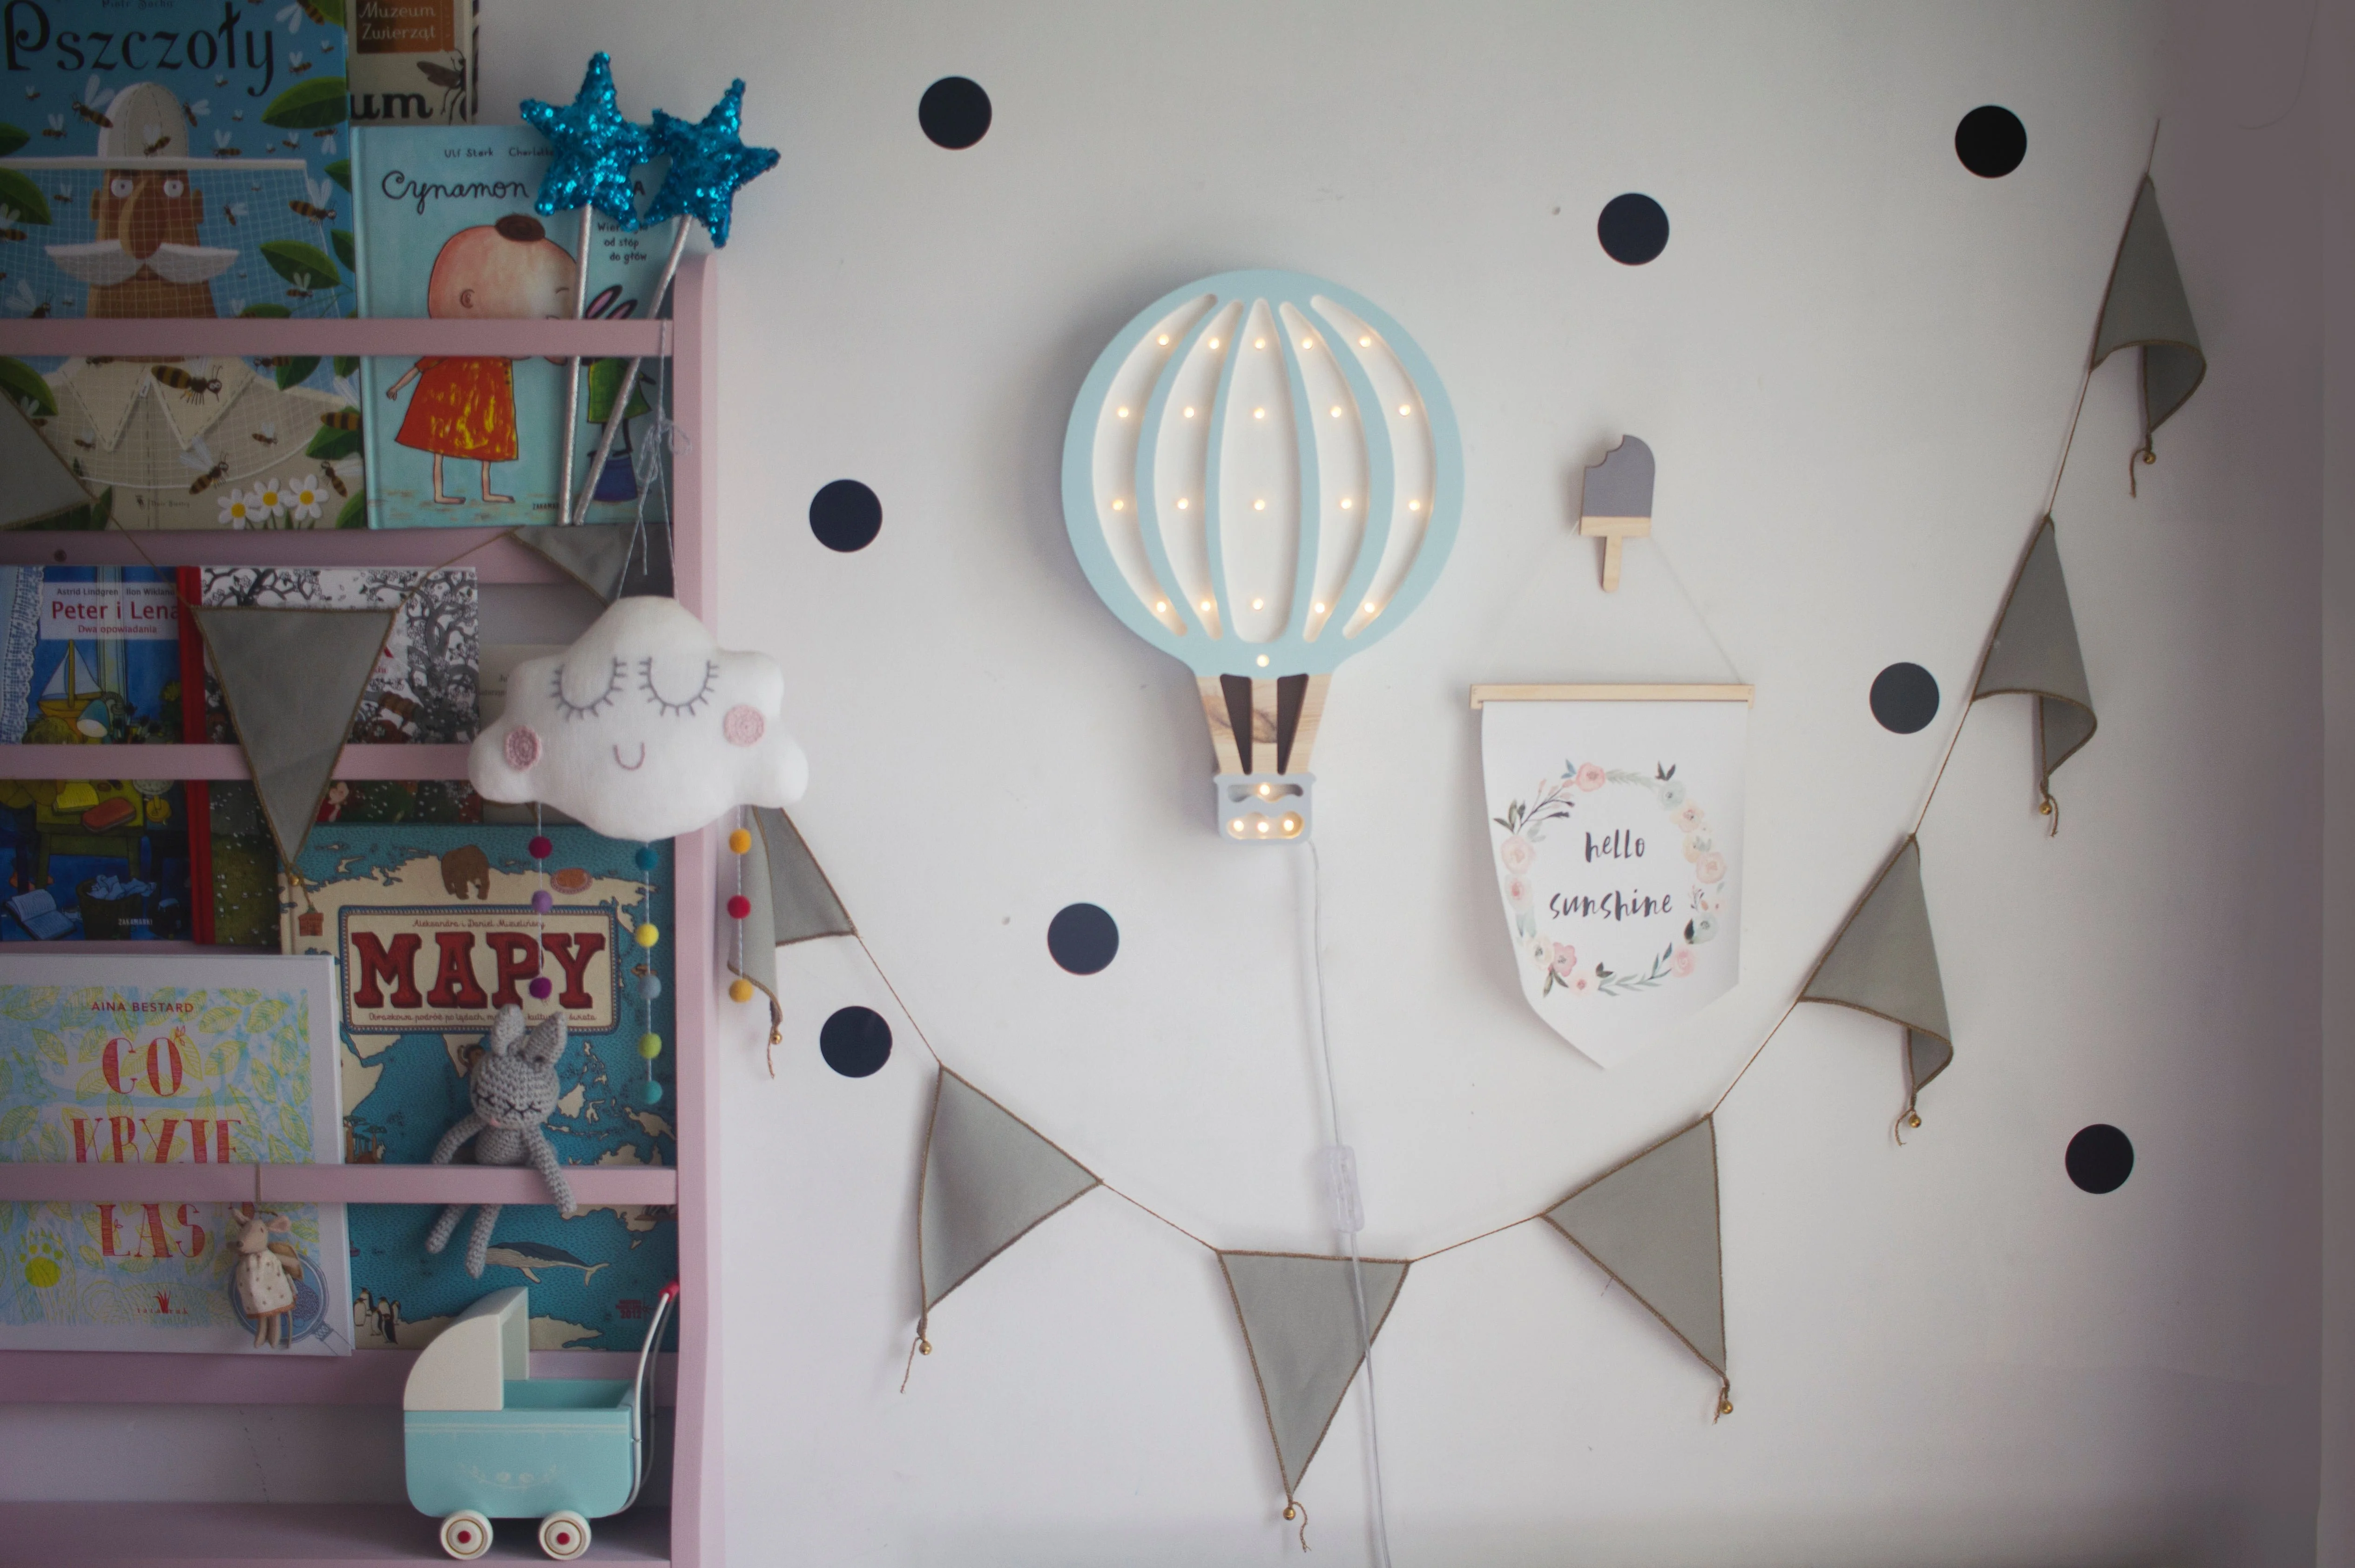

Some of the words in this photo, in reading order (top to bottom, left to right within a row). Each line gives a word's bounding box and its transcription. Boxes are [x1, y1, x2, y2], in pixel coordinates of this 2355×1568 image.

[359, 1, 436, 19] Muzeum
[4, 0, 274, 97] Pszczoły
[382, 171, 530, 215] Cynamon
[604, 237, 615, 247] od
[610, 252, 621, 261] do
[52, 601, 108, 619] Peter
[117, 601, 121, 619] i
[131, 601, 178, 619] Lena
[101, 625, 157, 634] opowiadania
[1585, 829, 1645, 862] hello
[1550, 889, 1672, 921] sunshine
[352, 932, 605, 1009] MAPY
[92, 1002, 126, 1012] AINA
[132, 1002, 194, 1013] BESTARD
[102, 1037, 183, 1097] CO
[96, 1204, 206, 1258] LAS
